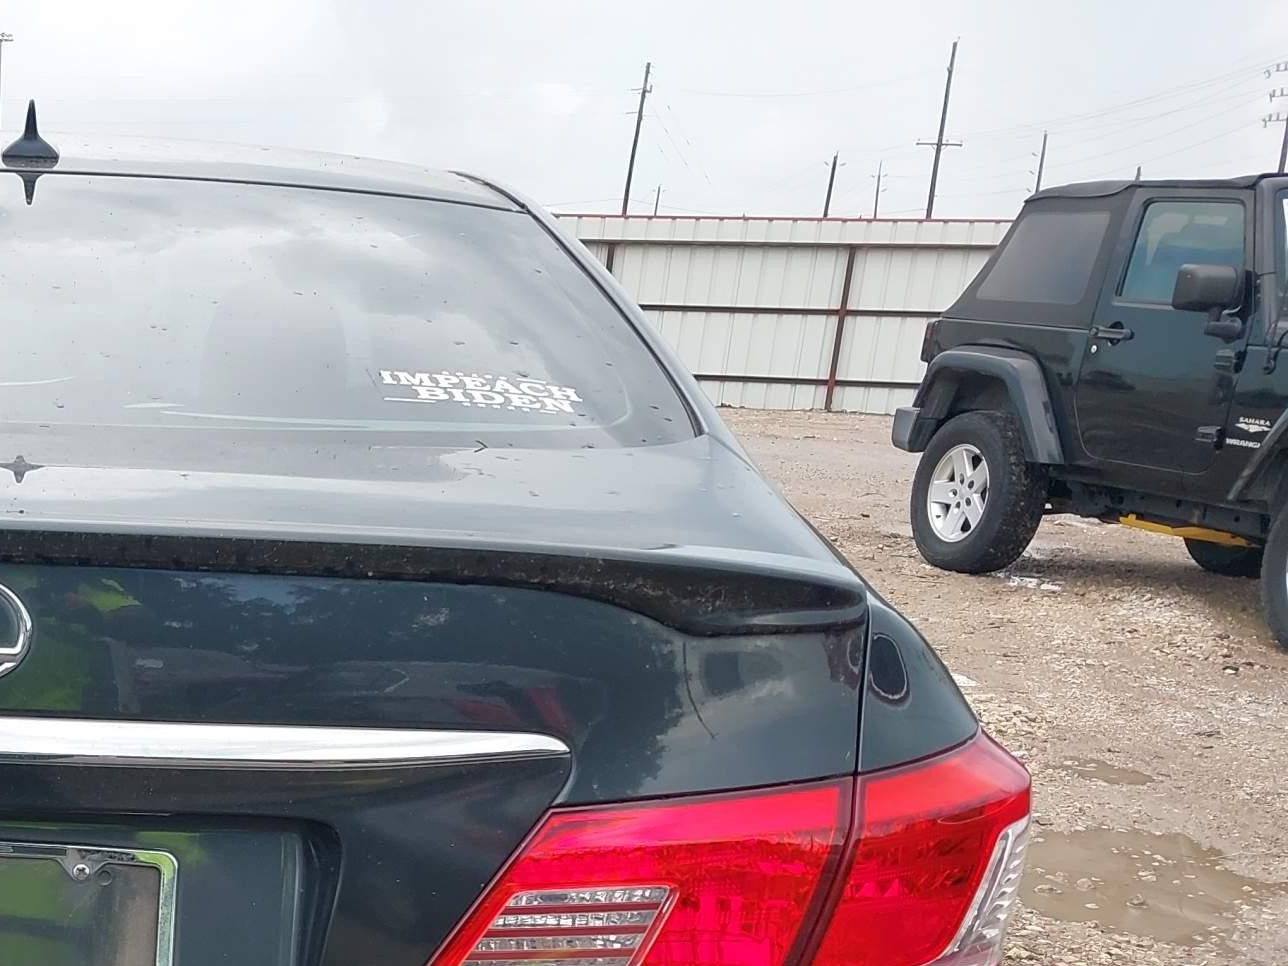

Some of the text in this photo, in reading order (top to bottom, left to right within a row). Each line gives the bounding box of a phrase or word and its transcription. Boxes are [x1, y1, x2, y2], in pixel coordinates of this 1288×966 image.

[379, 370, 583, 402] IMPEACH
[412, 386, 576, 413] BIDEN
[1239, 416, 1271, 426] SAHARA
